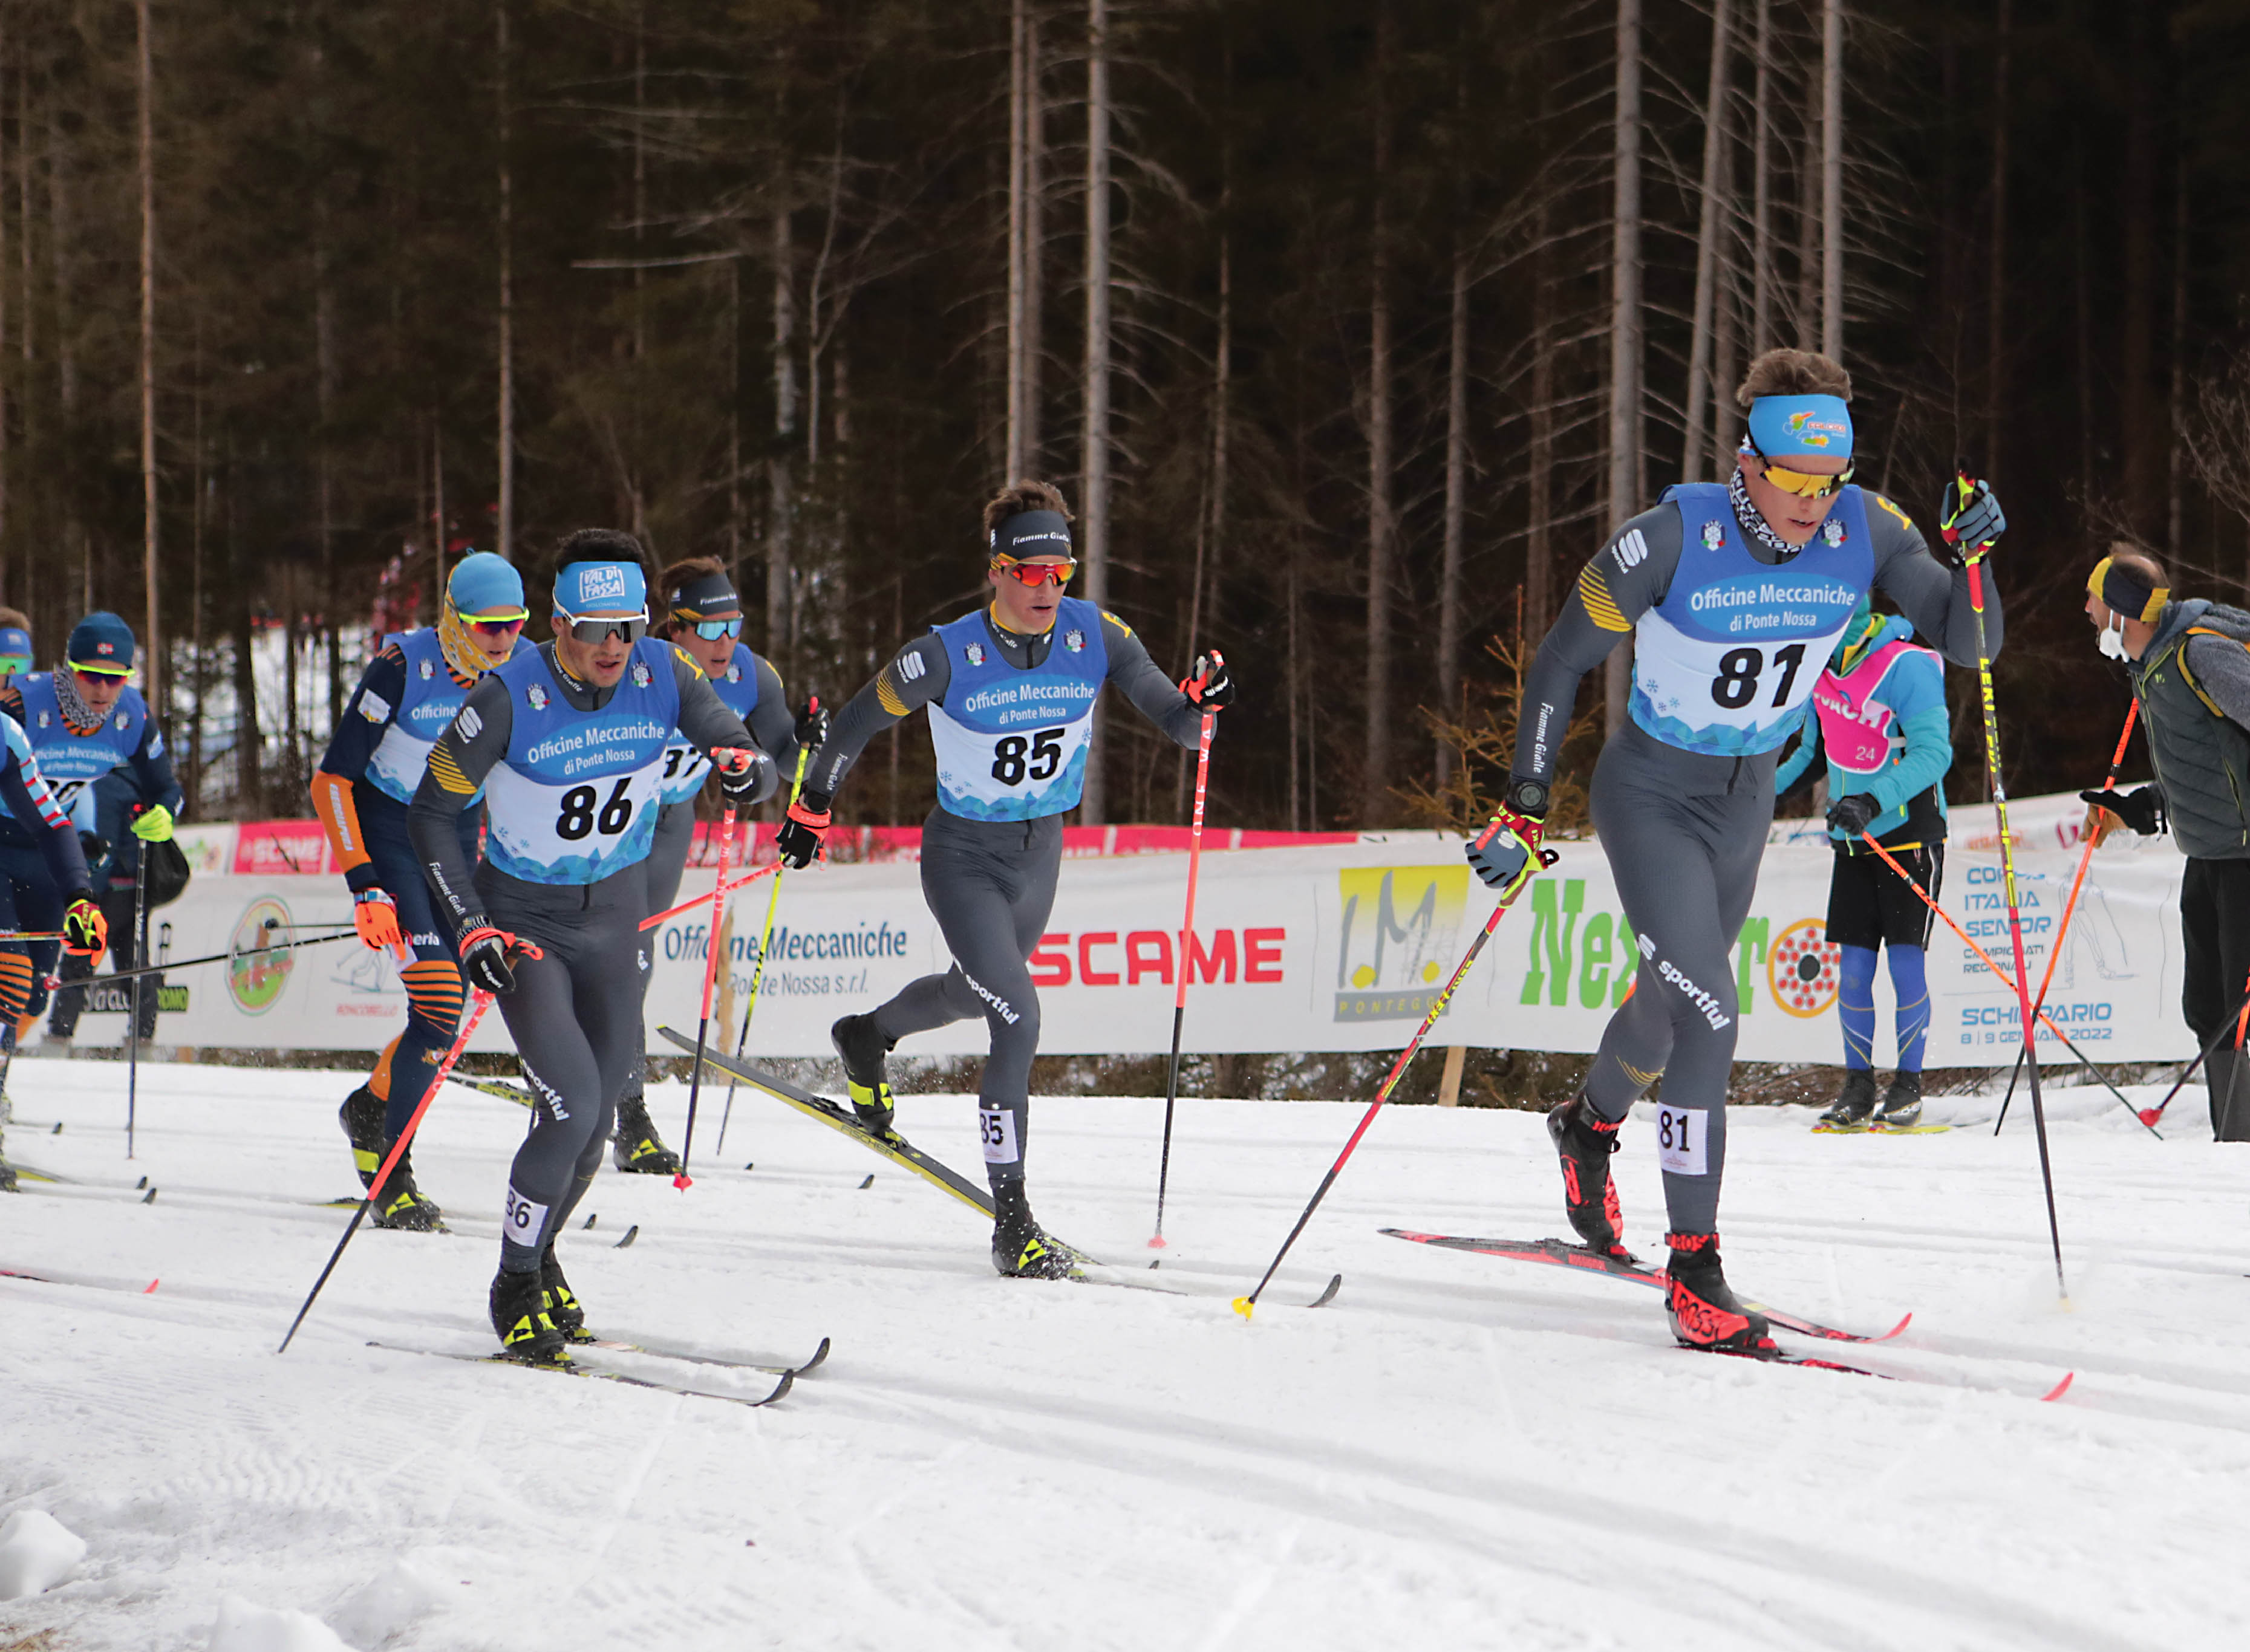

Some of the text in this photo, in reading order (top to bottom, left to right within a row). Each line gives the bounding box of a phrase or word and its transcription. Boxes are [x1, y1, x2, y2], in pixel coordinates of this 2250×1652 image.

[1012, 533, 1048, 546] Fiamme
[1611, 545, 1629, 574] sportful
[585, 570, 605, 583] VAL
[585, 581, 621, 598] FASSA
[1691, 584, 1855, 611] Officine Meccaniche
[1730, 611, 1817, 632] di Ponte Nossa
[1710, 643, 1807, 710] 81
[1980, 658, 1995, 711] LEKI
[411, 703, 457, 720] Officine
[966, 682, 1095, 712] Officine Meccaniche
[999, 705, 1066, 724] di Ponte Nossa
[527, 737, 584, 764] Officine
[585, 721, 665, 746] Meccaniche
[1533, 702, 1554, 773] Fiamme Gialle
[564, 749, 635, 775] di Ponte Nossa
[991, 727, 1066, 787] 85
[1854, 746, 1876, 761] 24
[556, 777, 633, 841] 86
[429, 861, 452, 897] Fiamme
[765, 920, 907, 961] Meccaniche
[1966, 916, 2051, 937] SENOR
[1028, 927, 1286, 987] SCAME
[782, 972, 830, 997] Nossa
[835, 968, 869, 993] s.r.l.
[1658, 960, 1731, 1031] sportful
[1339, 995, 1437, 1015] PONTEGG
[1961, 1003, 2112, 1026] SCHIPARIO
[1960, 1033, 1972, 1044] 8
[1984, 1032, 1995, 1044] 9
[2069, 1027, 2112, 1041] 2022
[841, 1124, 894, 1157] FISCHER
[1660, 1110, 1691, 1152] 81
